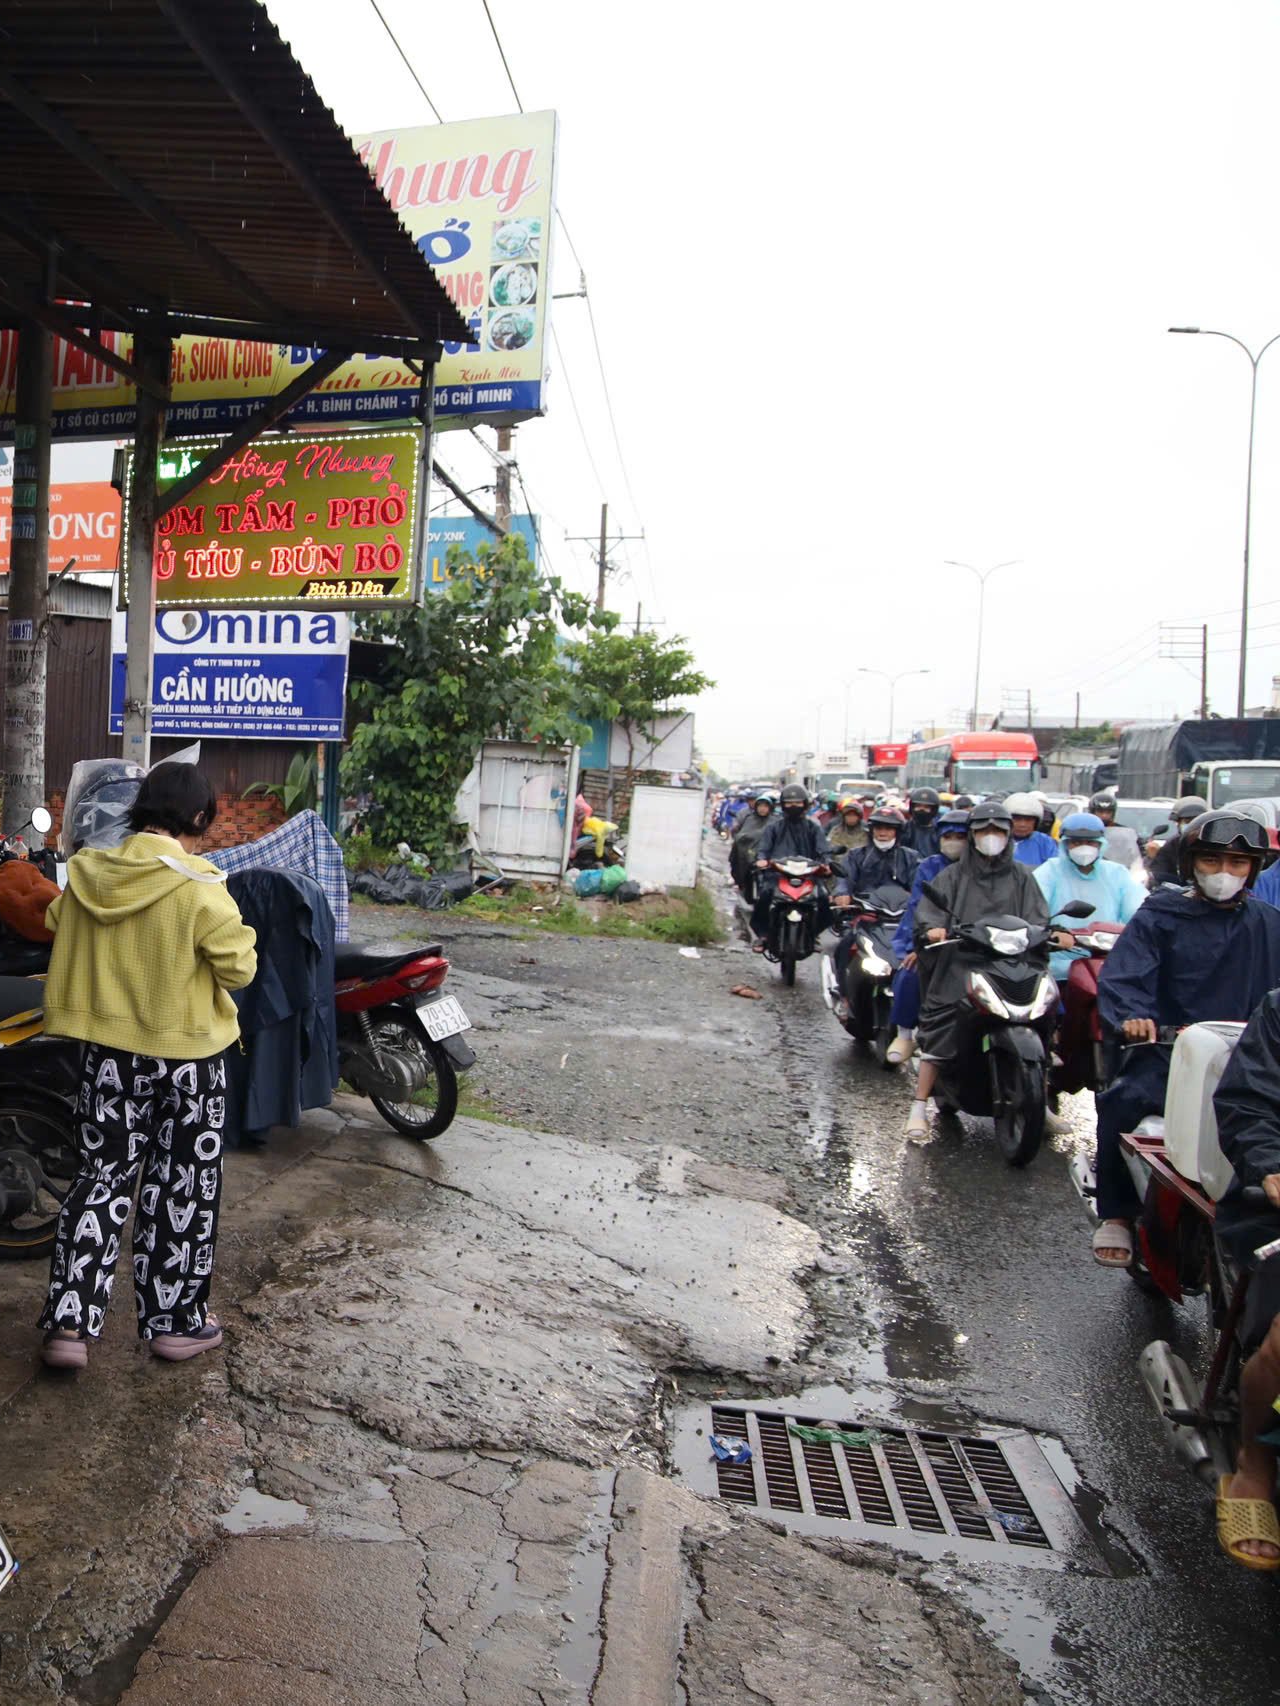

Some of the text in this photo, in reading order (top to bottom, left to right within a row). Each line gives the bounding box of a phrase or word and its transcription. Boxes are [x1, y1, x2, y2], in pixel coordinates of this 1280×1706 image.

[356, 139, 537, 213] hung
[417, 218, 472, 265] Ở
[322, 395, 352, 412] BÌNH
[355, 393, 399, 411] CHÁNH
[476, 387, 513, 404] MINH
[209, 449, 288, 488] Hồng
[295, 444, 396, 483] Nhung
[325, 482, 409, 530] PHỞ
[268, 536, 346, 577] BÚN
[352, 533, 404, 575] BÒ
[443, 531, 466, 541] XNK
[160, 666, 293, 703] CẦN HƯƠNG
